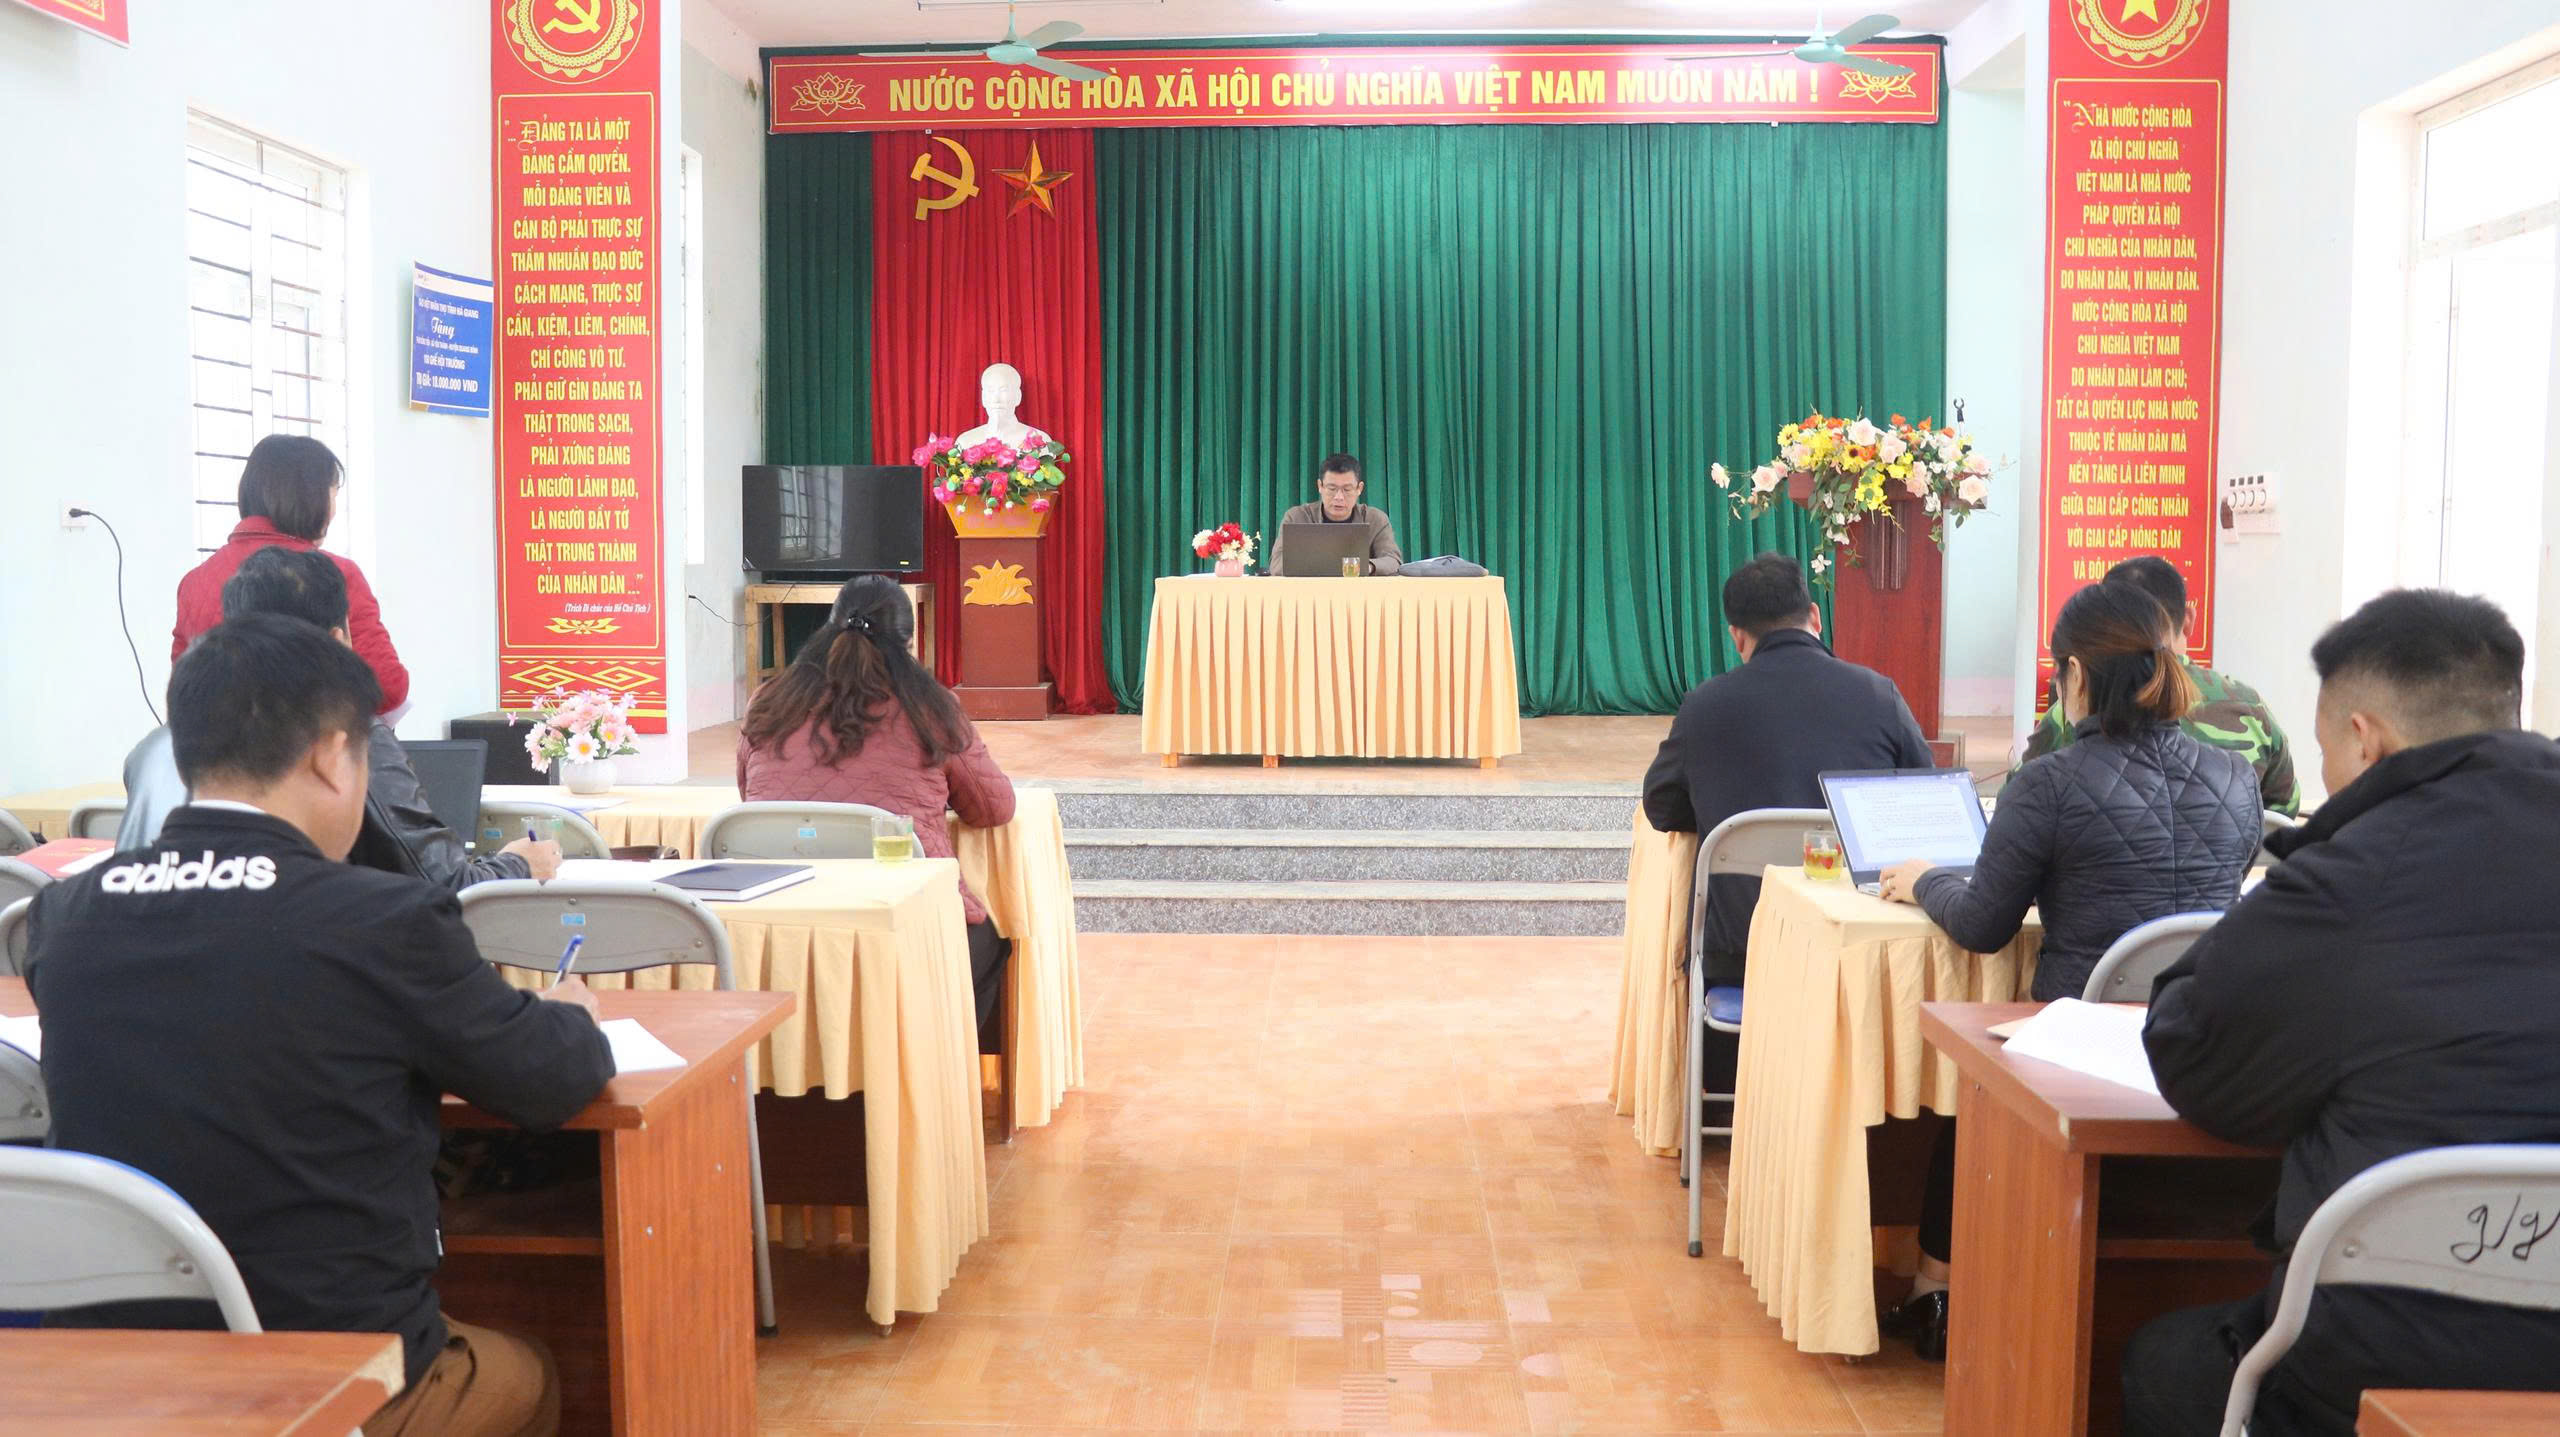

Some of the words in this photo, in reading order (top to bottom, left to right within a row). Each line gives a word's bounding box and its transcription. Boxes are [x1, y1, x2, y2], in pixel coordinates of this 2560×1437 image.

[889, 68, 975, 112] NƯỚC
[985, 70, 1071, 117] CỘNG
[1082, 67, 1146, 109] HÒA
[1155, 67, 1198, 108] XÃ
[1208, 66, 1261, 114] HỘI
[1272, 57, 1335, 106] CHỦ
[1346, 65, 1443, 105] NGHĨA
[1455, 63, 1521, 112] VIỆT
[1531, 70, 1606, 104] NAM
[1617, 64, 1712, 103] MUÔN
[1723, 62, 1797, 103] NĂM
[2112, 102, 2139, 127] NƯỚC
[2142, 104, 2169, 133] CỘNG
[2172, 104, 2192, 127] HÒA
[569, 122, 583, 141] TA
[587, 117, 601, 141] LÀ
[605, 117, 630, 147] MỘT
[522, 147, 555, 174] ĐẢNG
[2090, 136, 2103, 160] XÃ
[2106, 136, 2122, 164] HỘI
[2126, 132, 2145, 160] CHỦ
[2148, 137, 2178, 160] NGHĨA
[549, 178, 582, 206] ĐẢNG
[585, 182, 612, 206] VIÊN
[616, 182, 631, 205] VÀ
[2076, 168, 2097, 196] VIỆT
[2100, 172, 2123, 192] NAM
[2126, 169, 2138, 192] LÀ
[2141, 169, 2161, 192] NHÀ
[2164, 168, 2191, 192] NƯỚC
[514, 216, 538, 239] CÁN
[541, 215, 557, 243] BỘ
[561, 211, 588, 239] PHẢI
[592, 217, 622, 242] THỰC
[625, 216, 642, 242] SỰ
[2083, 202, 2110, 224] PHÁP
[2148, 202, 2161, 225] XÃ
[2164, 202, 2180, 229] HỘI
[2065, 229, 2085, 257] CHỦ
[2087, 234, 2118, 257] NGHĨA
[2121, 230, 2140, 257] CỦA
[2143, 234, 2171, 258] NHÂN
[2174, 235, 2197, 260] DÂN,
[592, 251, 616, 275] ĐẠO
[619, 245, 643, 270] ĐỨC
[2060, 269, 2075, 290] DO
[2077, 266, 2105, 290] NHÂN
[2107, 266, 2131, 292] DÂN,
[2134, 267, 2143, 290] VÌ
[2146, 267, 2173, 290] NHÂN
[2176, 267, 2199, 290] DÂN.
[515, 281, 546, 304] CÁCH
[550, 284, 588, 307] MẠNG,
[592, 282, 622, 307] THỰC
[625, 281, 642, 307] SỰ
[2072, 296, 2099, 323] NƯỚC
[2102, 298, 2129, 327] CỘNG
[2132, 298, 2151, 322] HÒA
[2155, 300, 2167, 323] XÃ
[2171, 300, 2187, 327] HỘI
[431, 316, 455, 339] Tặng
[538, 313, 571, 340] KIỆM,
[575, 312, 606, 338] LIÊM,
[610, 312, 650, 338] CHÍNH,
[531, 345, 550, 368] CHÍ
[554, 345, 586, 368] CÔNG
[589, 344, 605, 368] VÔ
[608, 346, 626, 368] TƯ.
[2077, 326, 2098, 355] CHỦ
[2100, 331, 2131, 355] NGHĨA
[2133, 331, 2154, 359] VIỆT
[2157, 336, 2179, 355] NAM
[515, 374, 542, 400] PHẢI
[546, 376, 566, 400] GIỮ
[569, 377, 589, 400] GÌN
[592, 372, 625, 400] ĐẢNG
[627, 380, 643, 400] TA
[2071, 367, 2085, 387] DO
[2086, 363, 2115, 387] NHÂN
[2117, 364, 2138, 387] DÂN
[2141, 364, 2162, 387] LÀM
[2076, 391, 2090, 420] CẢ
[2127, 398, 2145, 423] LỰC
[2148, 396, 2168, 420] NHÀ
[2171, 396, 2198, 420] NƯỚC
[524, 410, 552, 437] THẬT
[556, 413, 594, 433] TRONG
[598, 413, 633, 437] SẠCH,
[531, 438, 558, 465] PHẢI
[562, 440, 594, 465] XỨNG
[598, 442, 631, 466] ĐÁNG
[2069, 427, 2101, 457] THUỘC
[2117, 428, 2145, 452] NHÂN
[2148, 429, 2168, 452] DÂN
[2171, 429, 2186, 452] MÀ
[2091, 455, 2118, 484] TẢNG
[2120, 460, 2132, 484] LÀ
[2135, 461, 2156, 484] LIÊN
[2159, 465, 2185, 484] MINH
[521, 474, 534, 497] LÀ
[538, 473, 574, 497] NGƯỜI
[577, 474, 608, 498] LÃNH
[611, 477, 639, 502] ĐẠO,
[531, 507, 545, 529] LÀ
[549, 505, 585, 530] NGƯỜI
[614, 503, 630, 530] TỚ
[2061, 491, 2084, 516] GIỮA
[2086, 496, 2107, 516] GIAI
[2132, 493, 2158, 516] CÔNG
[2161, 494, 2188, 516] NHÂN
[2086, 528, 2105, 548] GIAI
[2131, 525, 2158, 548] NÔNG
[2161, 525, 2181, 548] DÂN
[525, 539, 553, 568] THẬT
[556, 542, 595, 562] TRUNG
[598, 538, 637, 563] THÀNH
[538, 566, 561, 594] CỦA
[564, 571, 597, 594] NHÂN
[600, 571, 625, 594] DÂN
[2073, 556, 2086, 580] VÀ
[101, 850, 277, 894] adidas
